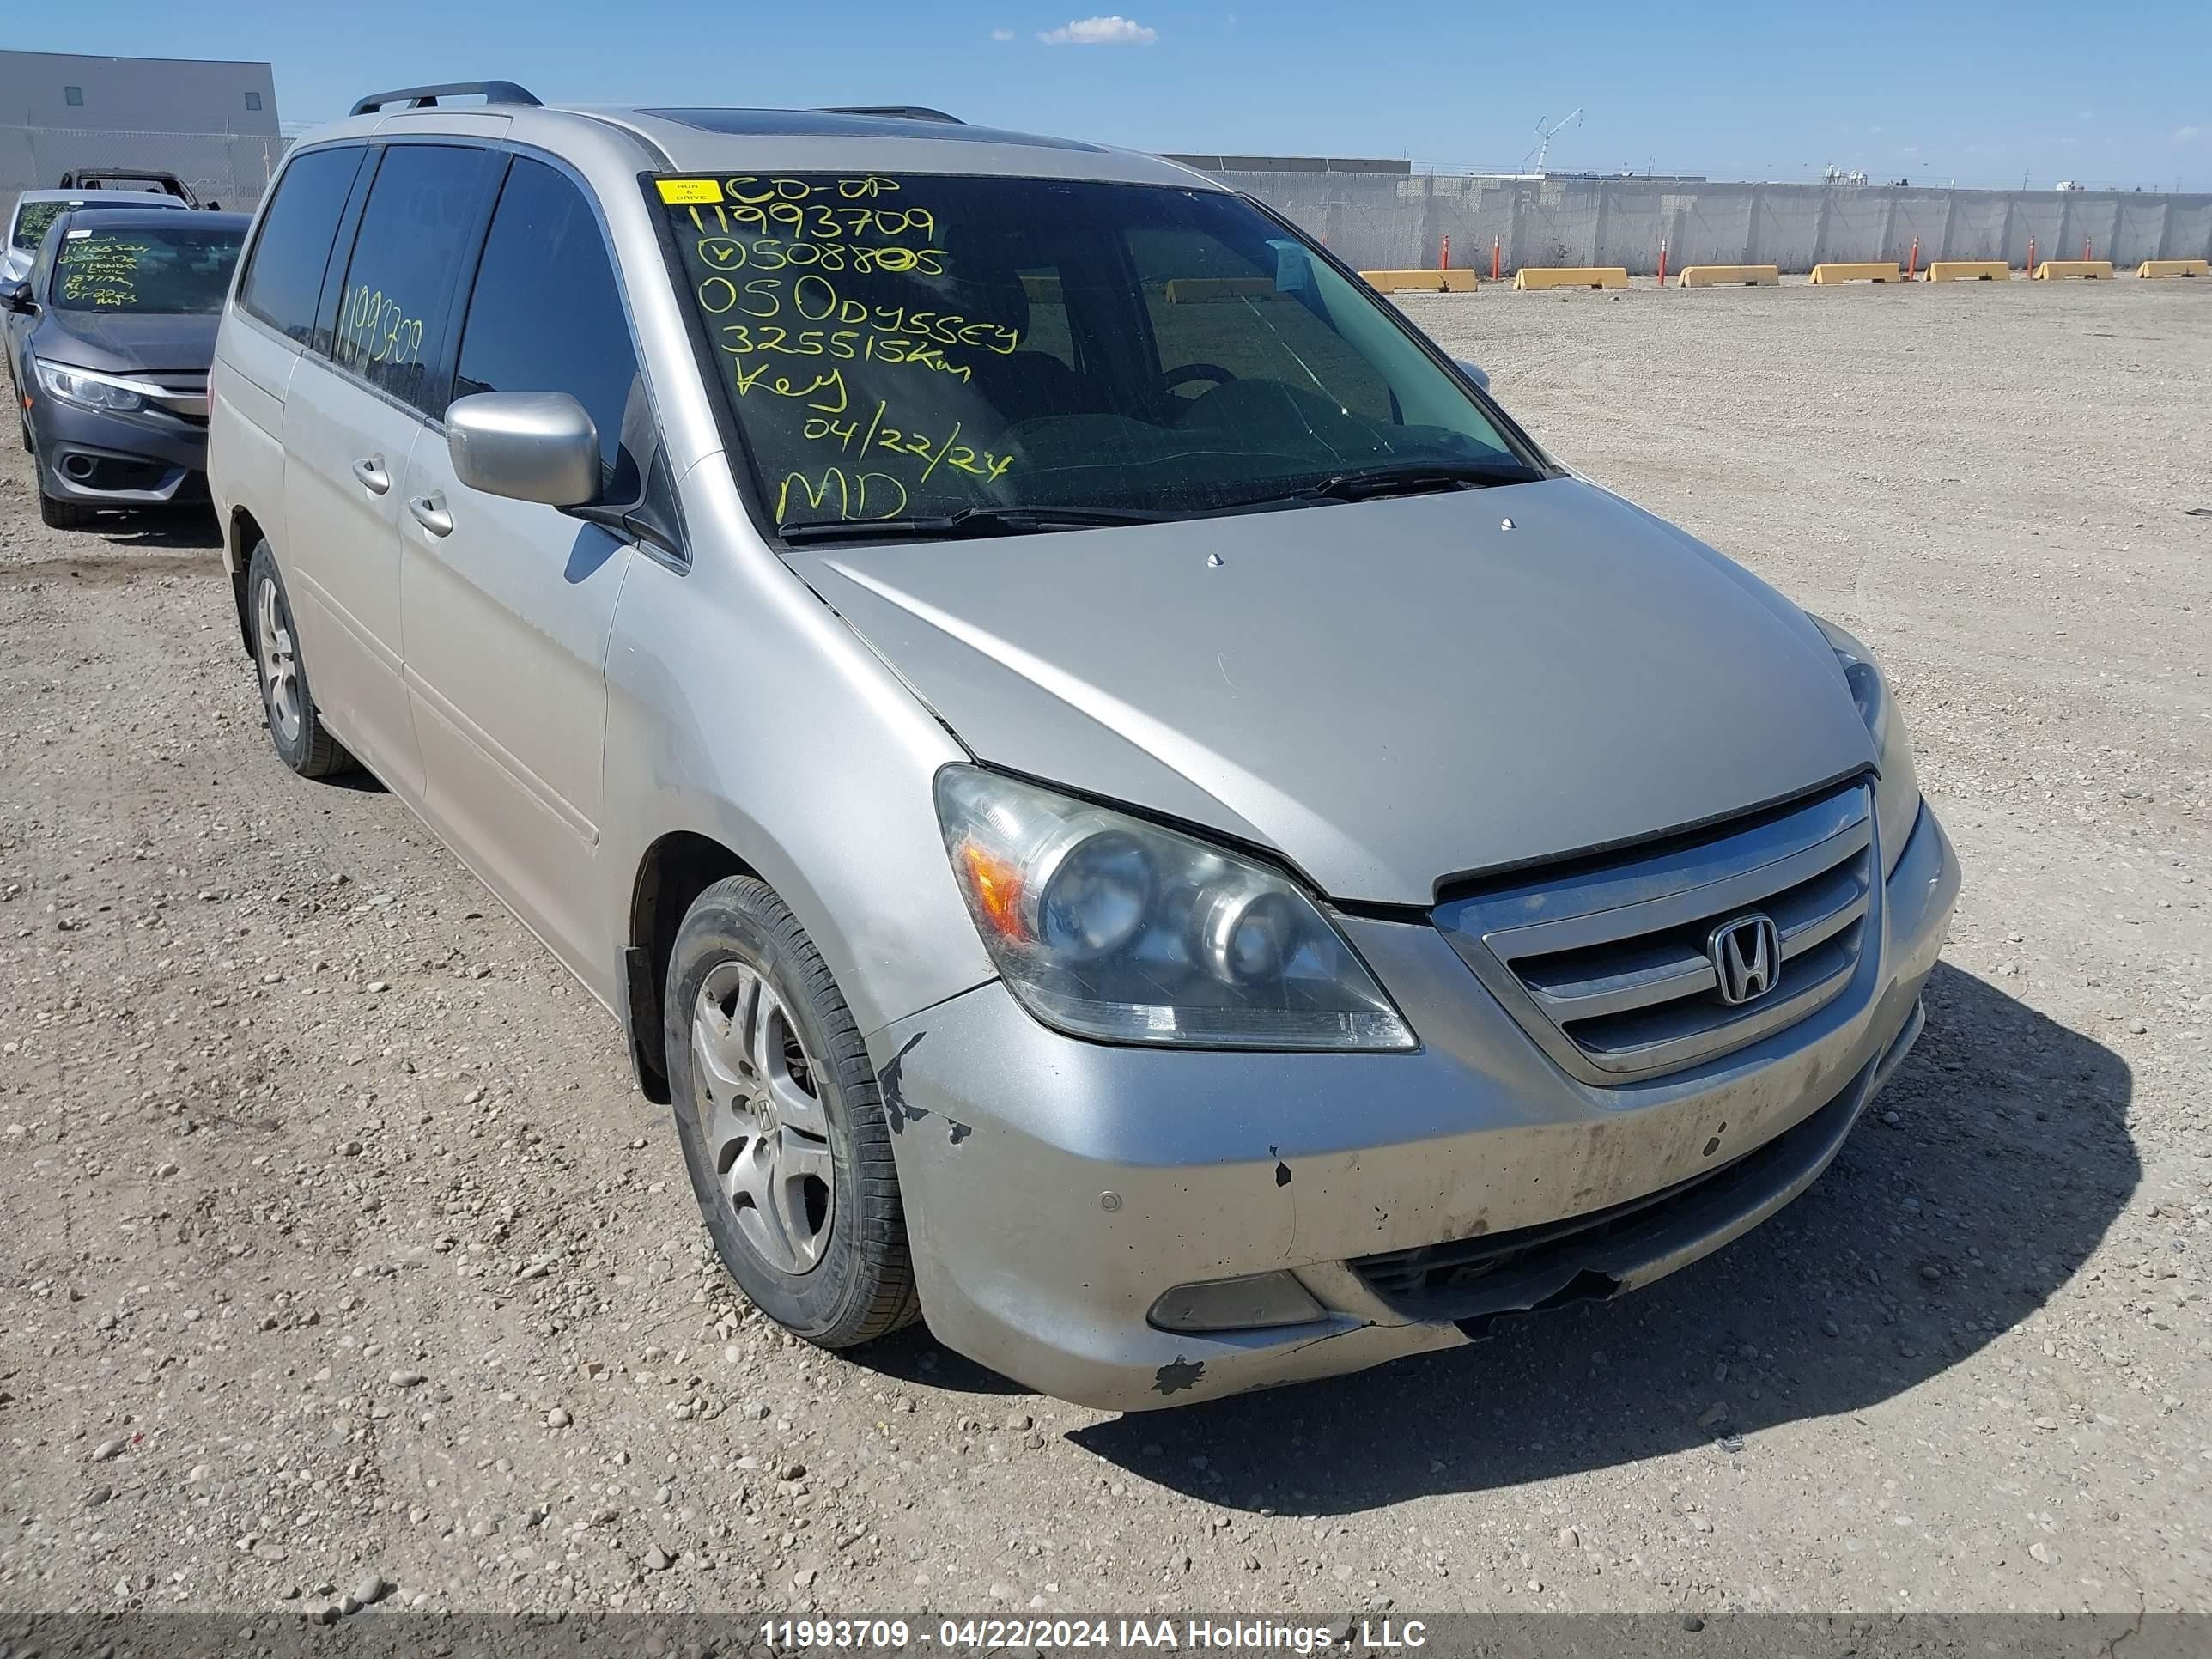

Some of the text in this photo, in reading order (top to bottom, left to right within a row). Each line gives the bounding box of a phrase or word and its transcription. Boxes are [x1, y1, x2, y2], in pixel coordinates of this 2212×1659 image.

[726, 177, 901, 204] CO-OP
[688, 204, 934, 242] 11993709
[336, 284, 422, 378] 11993709
[802, 400, 1015, 484] 04/22/24
[775, 467, 907, 524] MD
